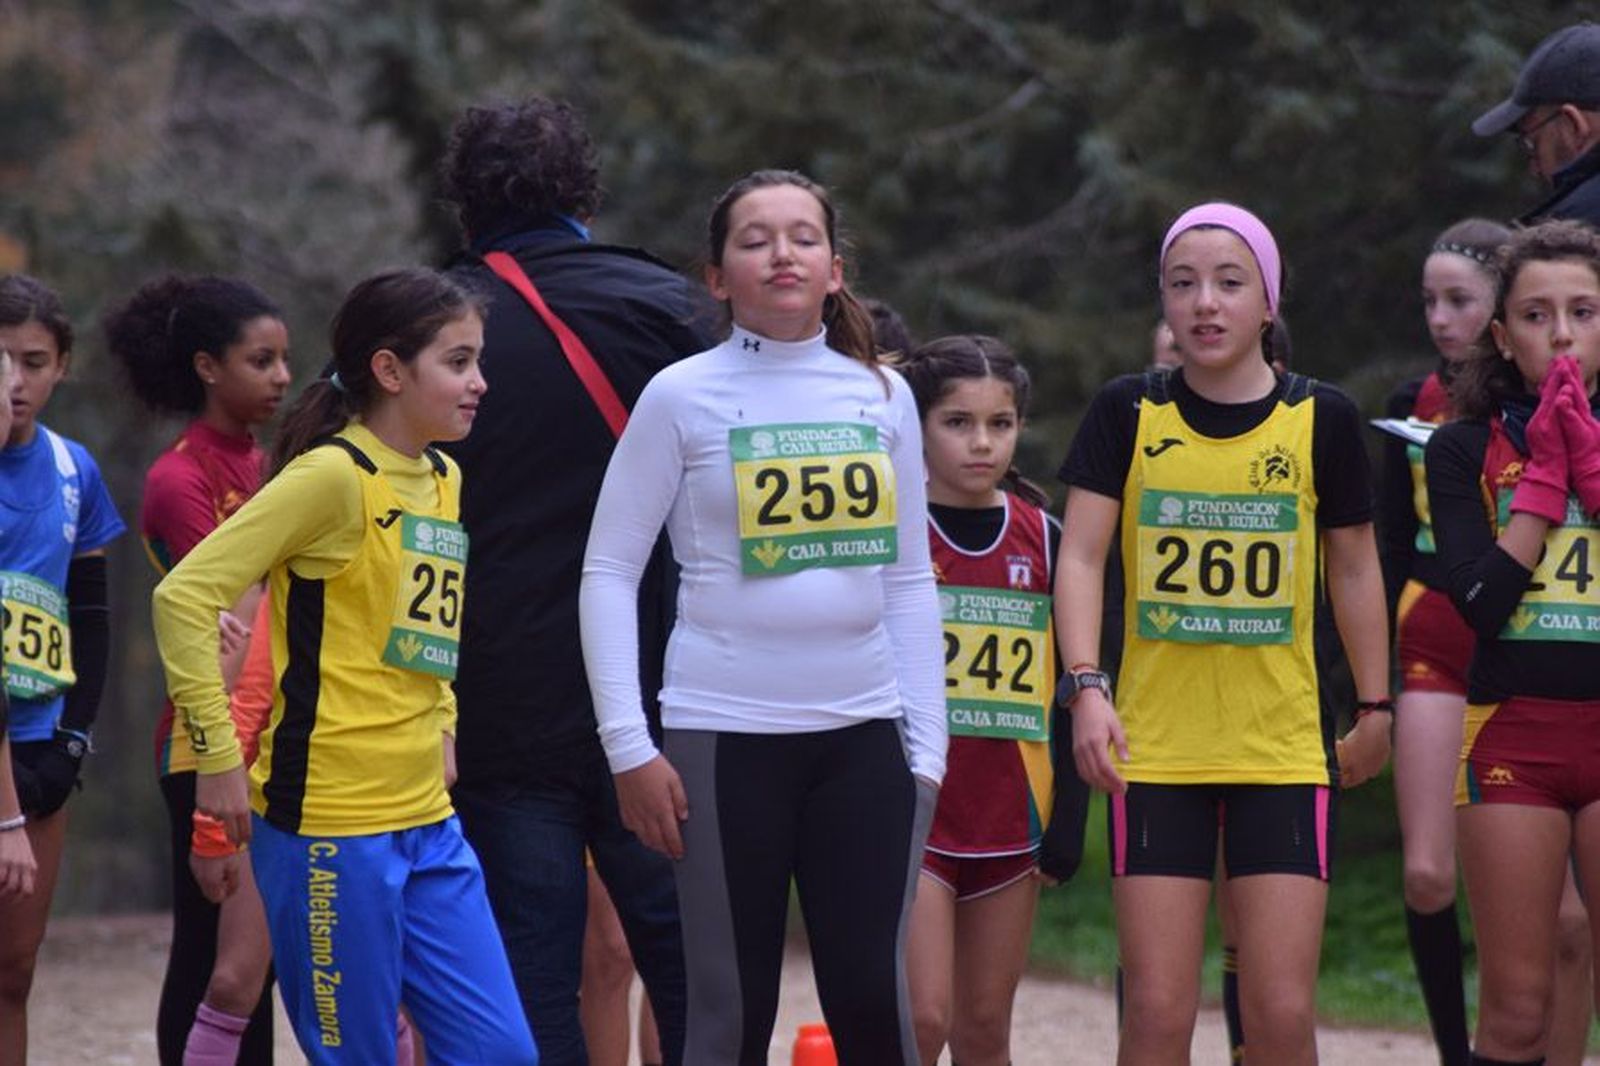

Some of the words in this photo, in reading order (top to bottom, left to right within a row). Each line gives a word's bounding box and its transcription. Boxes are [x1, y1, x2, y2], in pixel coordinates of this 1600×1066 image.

[755, 462, 879, 526] 259
[1187, 513, 1224, 528] CAJA
[1228, 515, 1280, 530] RURAL
[787, 543, 828, 560] CAJA
[831, 539, 890, 556] RURAL
[1155, 536, 1281, 598] 260
[960, 608, 994, 622] CAJA
[997, 611, 1033, 627] RURAL
[1180, 616, 1223, 633] CAJA
[1228, 618, 1285, 634] RURAL
[1538, 614, 1582, 630] CAJA
[423, 645, 449, 665] CAJA
[944, 632, 1034, 693] 242
[952, 709, 993, 727] CAJA
[996, 712, 1041, 731] RURAL
[308, 841, 339, 863] C.
[308, 866, 339, 966] Atletismo
[312, 970, 342, 1048] Zamora
